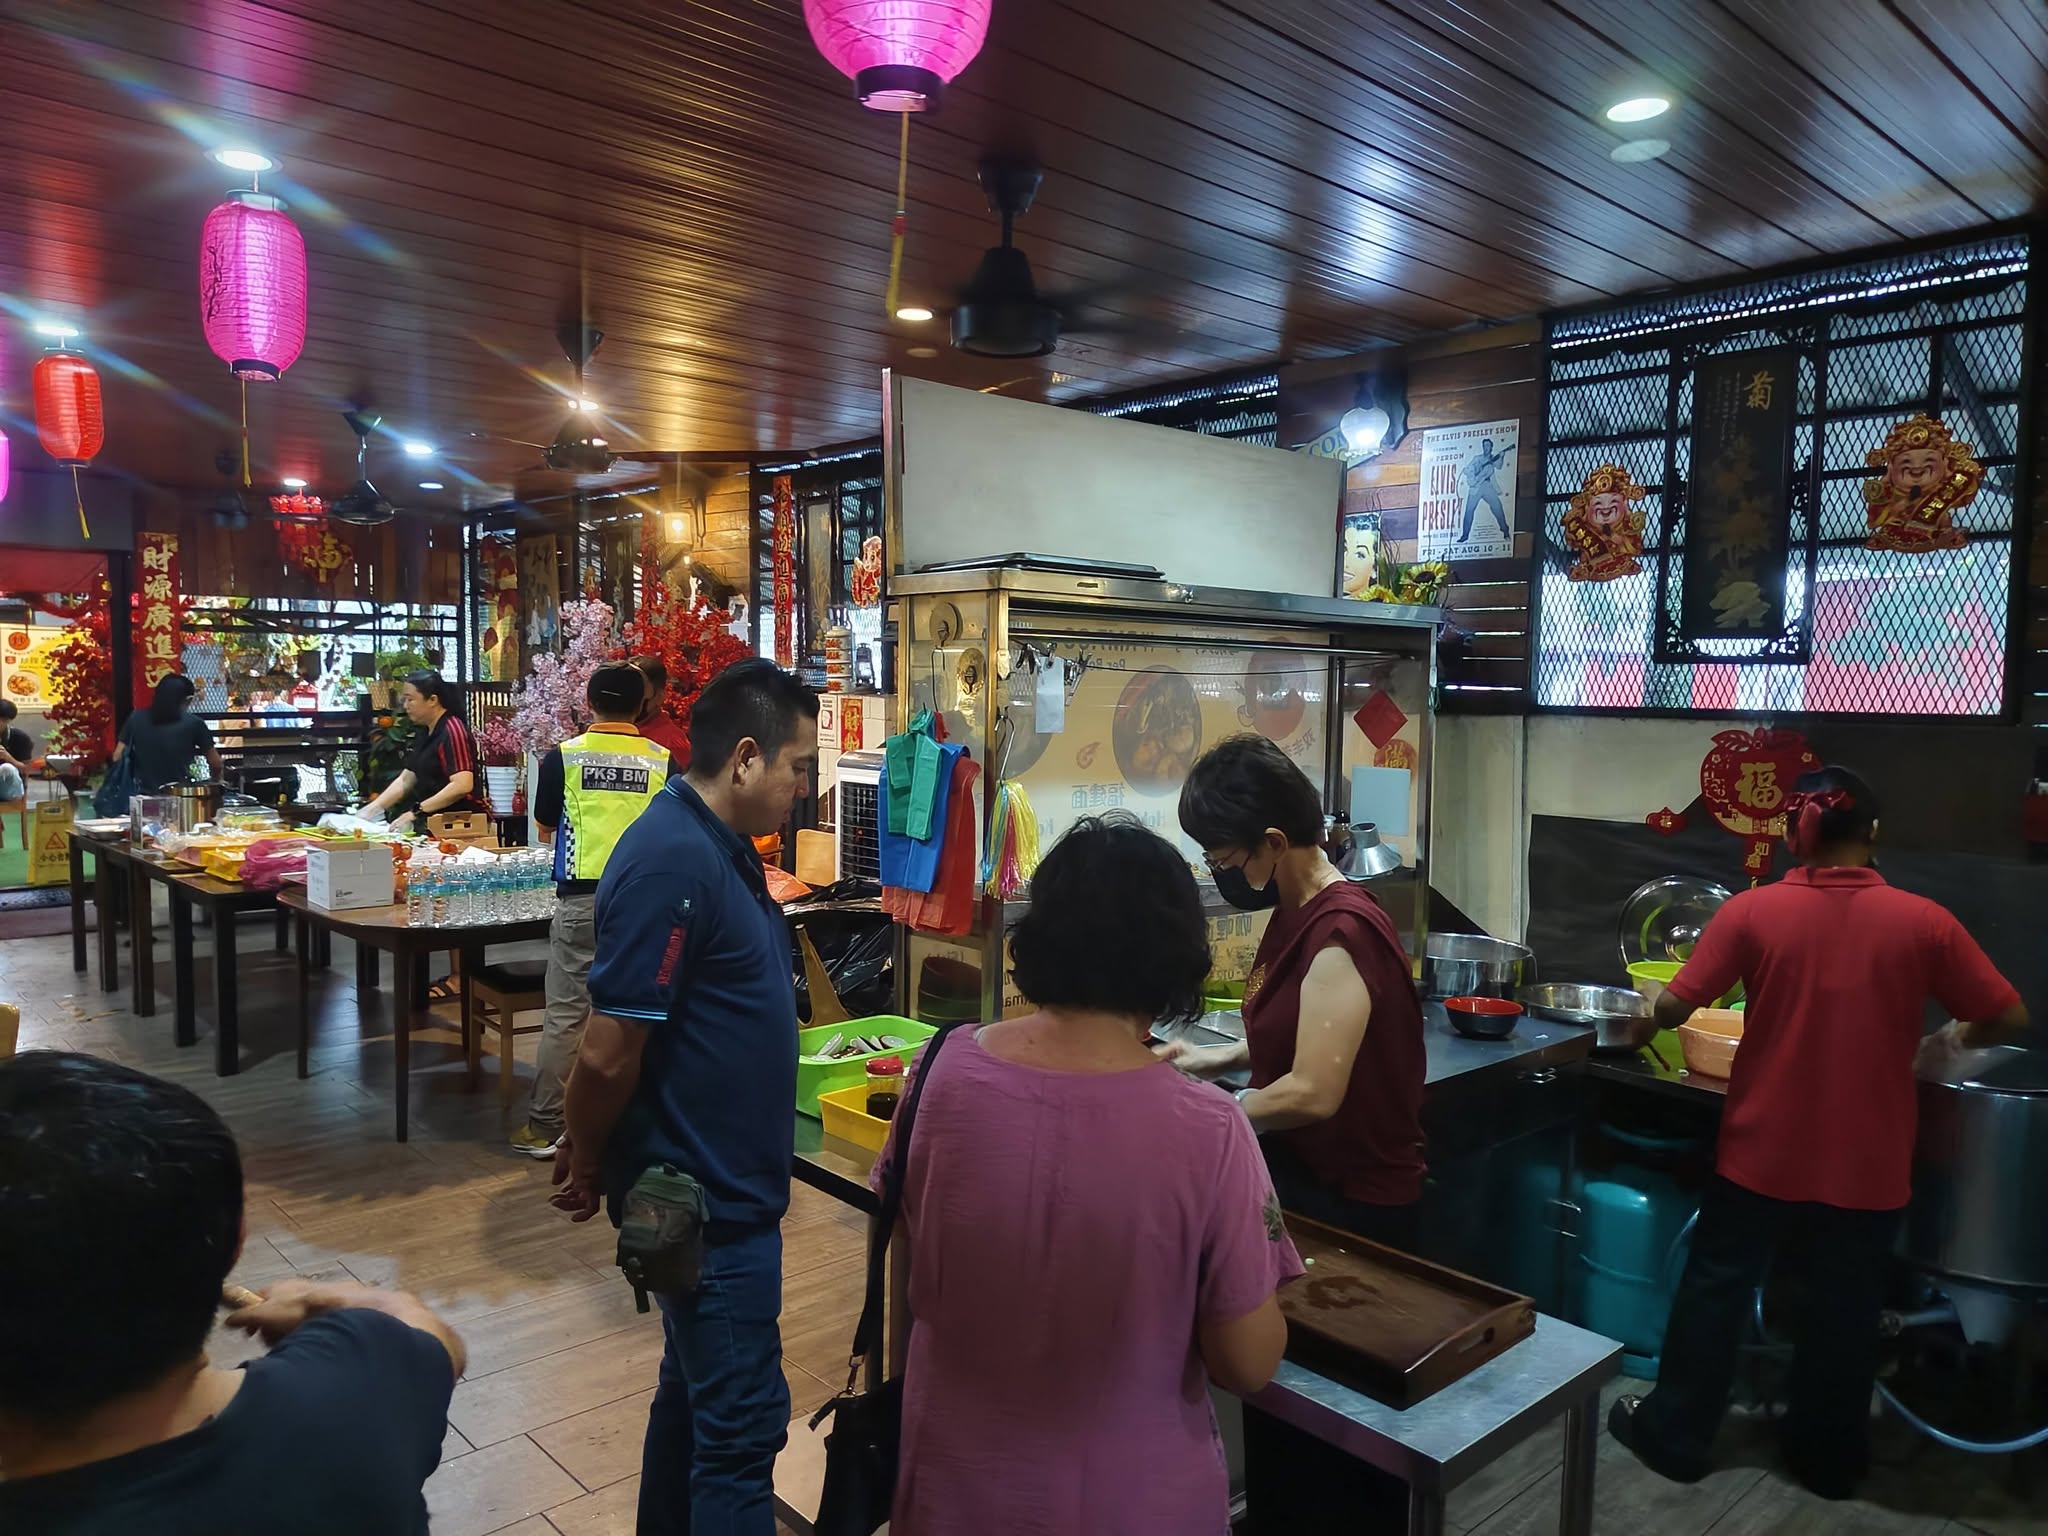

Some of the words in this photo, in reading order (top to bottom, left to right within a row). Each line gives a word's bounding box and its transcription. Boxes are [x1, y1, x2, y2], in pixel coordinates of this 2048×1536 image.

[1427, 435, 1440, 443] THE
[1442, 432, 1461, 441] ELVIS
[1463, 428, 1493, 438] PRESLEY
[1495, 424, 1518, 434] SHOW
[1436, 452, 1465, 462] PERSON
[1430, 463, 1457, 496] ELVIS
[1422, 497, 1464, 532] PRESLEY
[1422, 548, 1436, 556] FRI
[1443, 546, 1459, 555] SAT
[1461, 544, 1480, 554] AUG
[1484, 544, 1493, 552] 10
[583, 766, 618, 781] PKS
[622, 769, 648, 784] BM
[1735, 762, 1783, 809] 福
